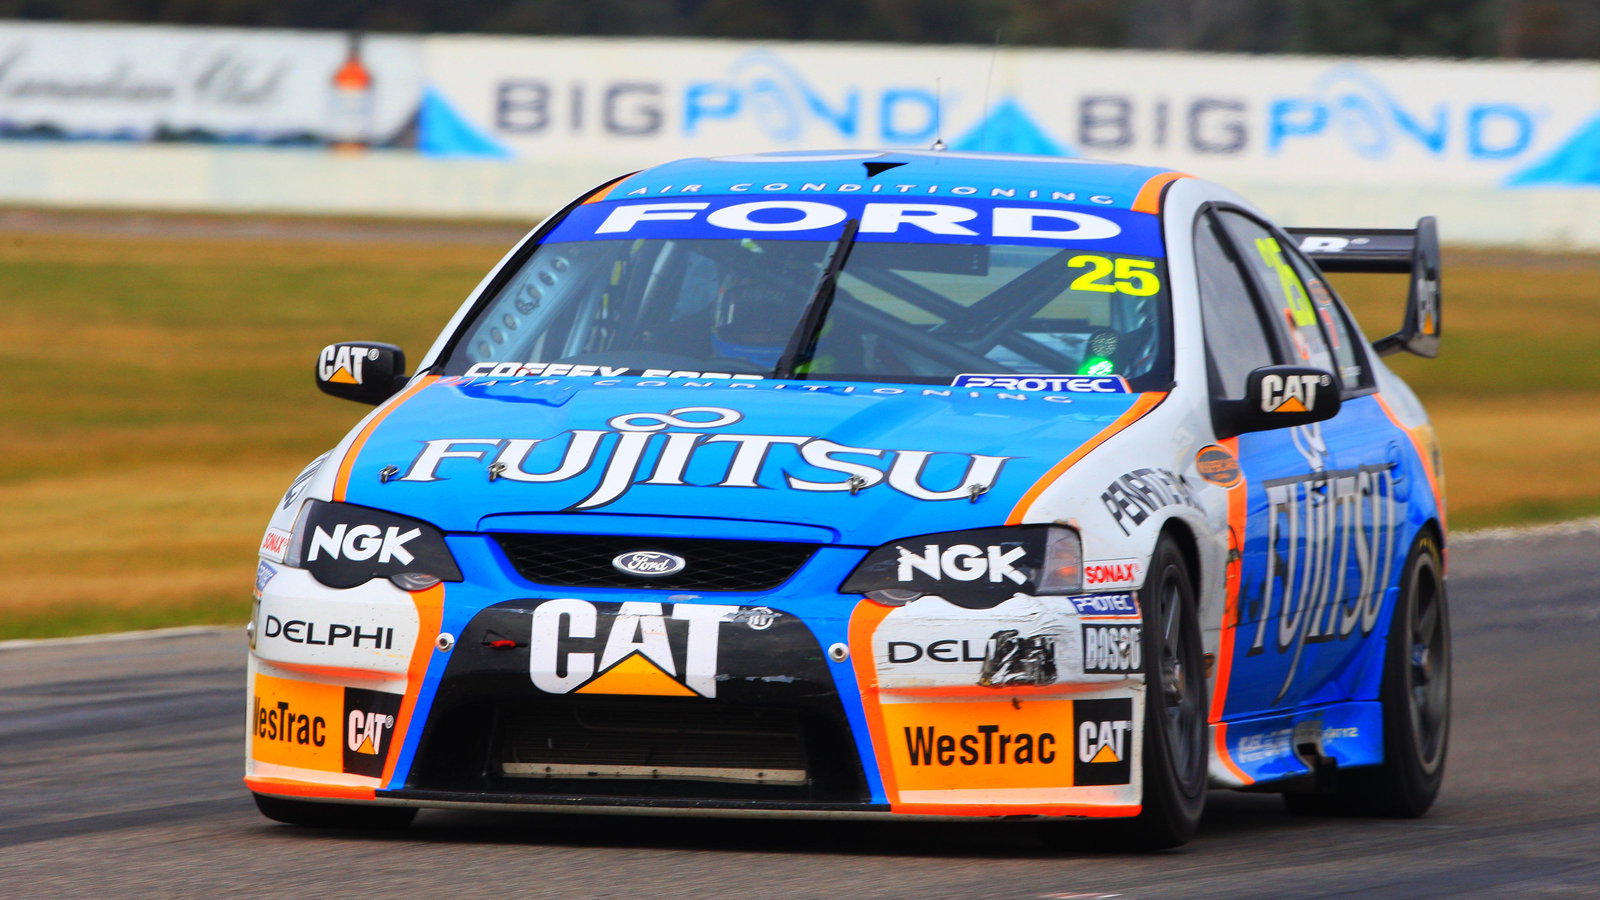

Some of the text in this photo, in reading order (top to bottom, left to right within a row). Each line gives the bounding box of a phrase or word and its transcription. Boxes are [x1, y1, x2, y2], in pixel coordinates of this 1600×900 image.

[627, 182, 1114, 205] AIR CONDITIONING
[594, 200, 1122, 240] FORD
[1067, 254, 1160, 297] 25
[319, 344, 369, 385] CAT
[964, 376, 1118, 393] PROTEC
[1260, 374, 1321, 413] CAT
[402, 428, 1012, 512] FUJITSU
[307, 523, 422, 566] NGK
[627, 552, 670, 572] Ford
[896, 544, 1027, 586] NGK
[1084, 562, 1136, 584] SONAX
[265, 614, 394, 650] DELPHI
[529, 598, 740, 699] CAT
[348, 709, 387, 755] CAT
[903, 720, 1128, 767] WesTrac CAT
